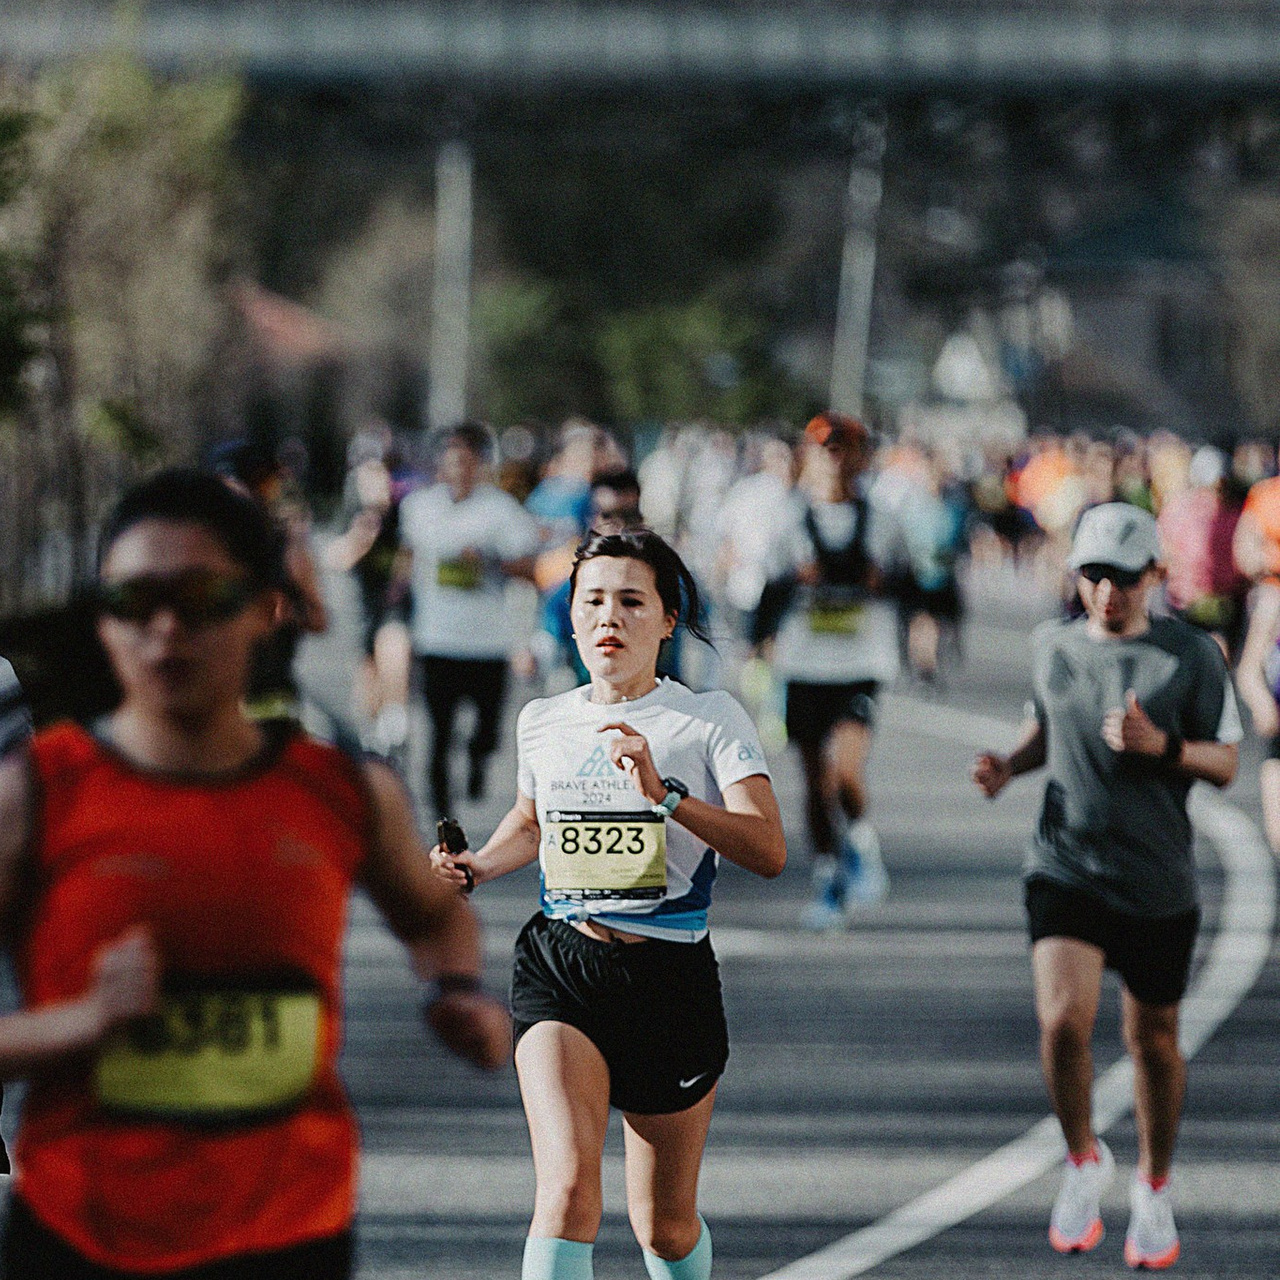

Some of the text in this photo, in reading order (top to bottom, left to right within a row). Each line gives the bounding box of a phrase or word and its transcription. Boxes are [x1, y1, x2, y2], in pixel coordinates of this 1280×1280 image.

[550, 780, 586, 791] BRAVE
[582, 793, 612, 804] 2024
[561, 827, 645, 855] 8323
